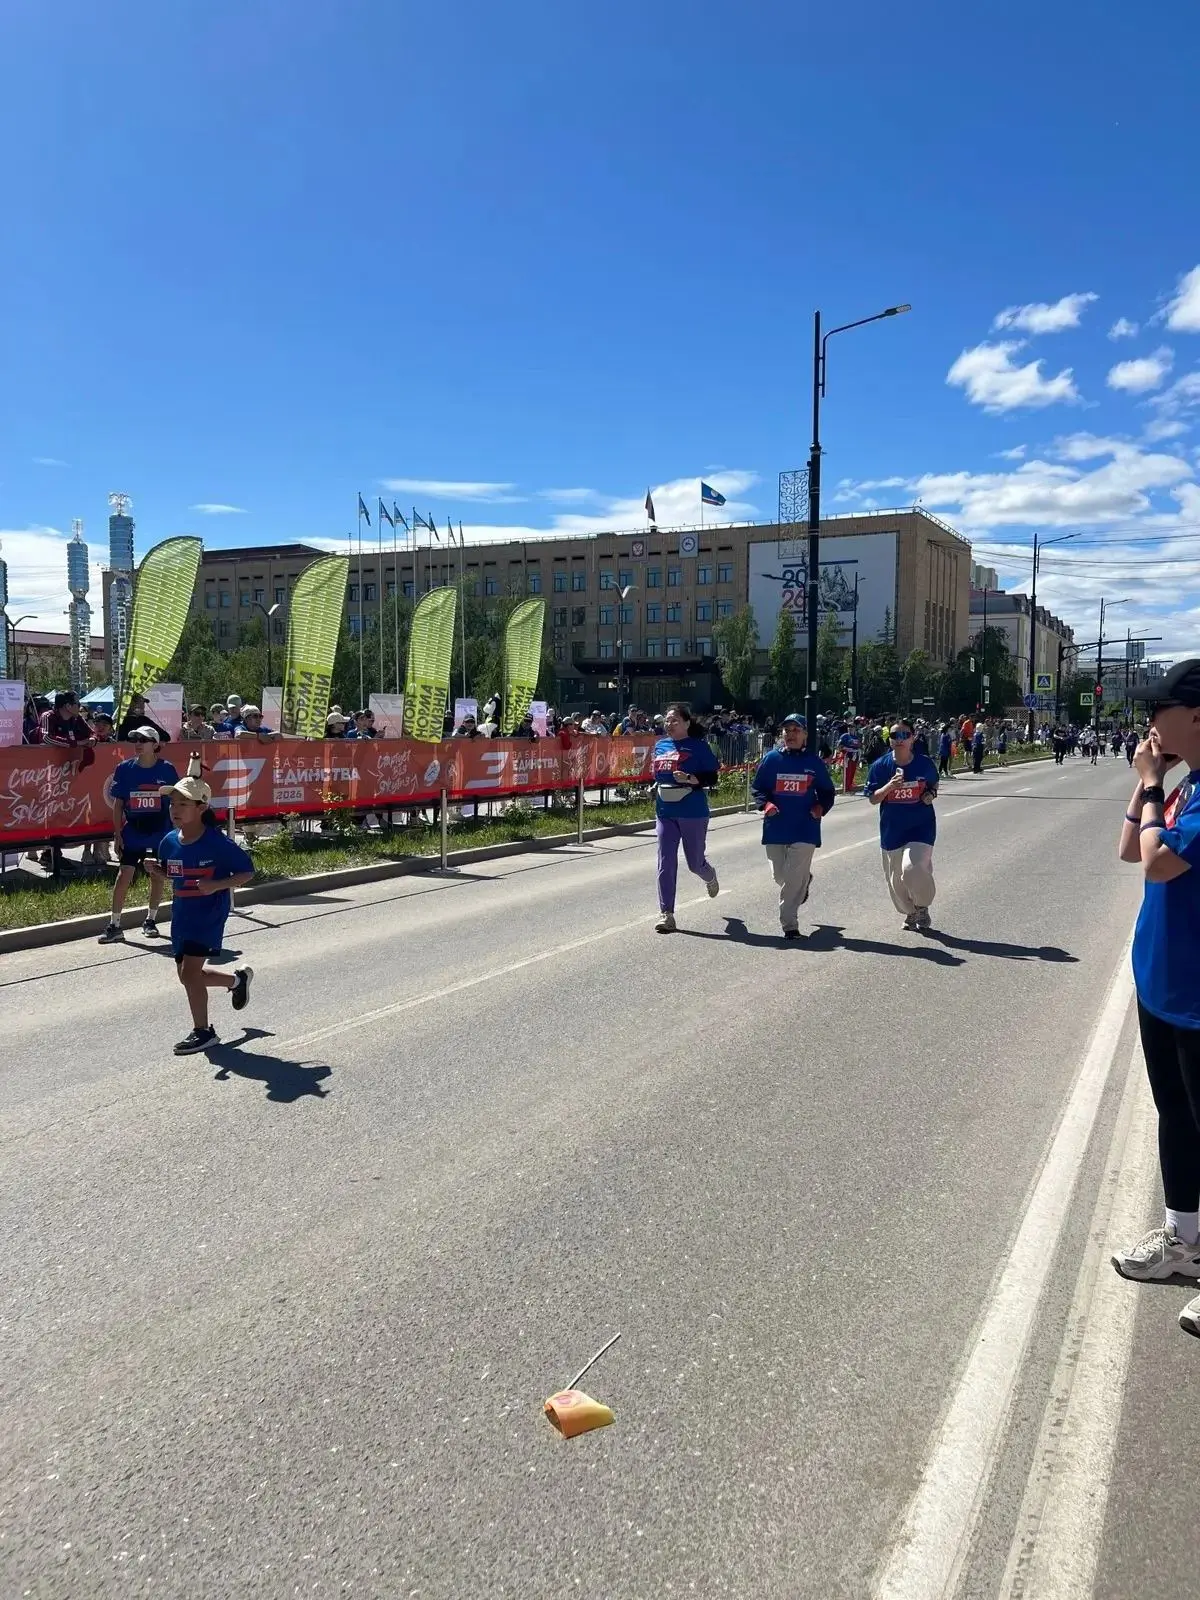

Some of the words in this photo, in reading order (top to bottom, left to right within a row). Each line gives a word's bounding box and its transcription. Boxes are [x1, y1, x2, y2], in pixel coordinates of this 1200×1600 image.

[297, 671, 314, 734] НОРМА
[309, 674, 330, 735] ЖИЗНИ
[415, 685, 432, 737] НОРМА
[429, 687, 446, 739] ЖИЗНИ
[273, 756, 338, 768] ЗАБЕГ
[512, 758, 559, 772] ЕДИНСТВА
[273, 767, 361, 785] ЕДИНСТВА
[783, 781, 800, 791] 231
[894, 788, 913, 799] 233
[137, 798, 155, 808] 700
